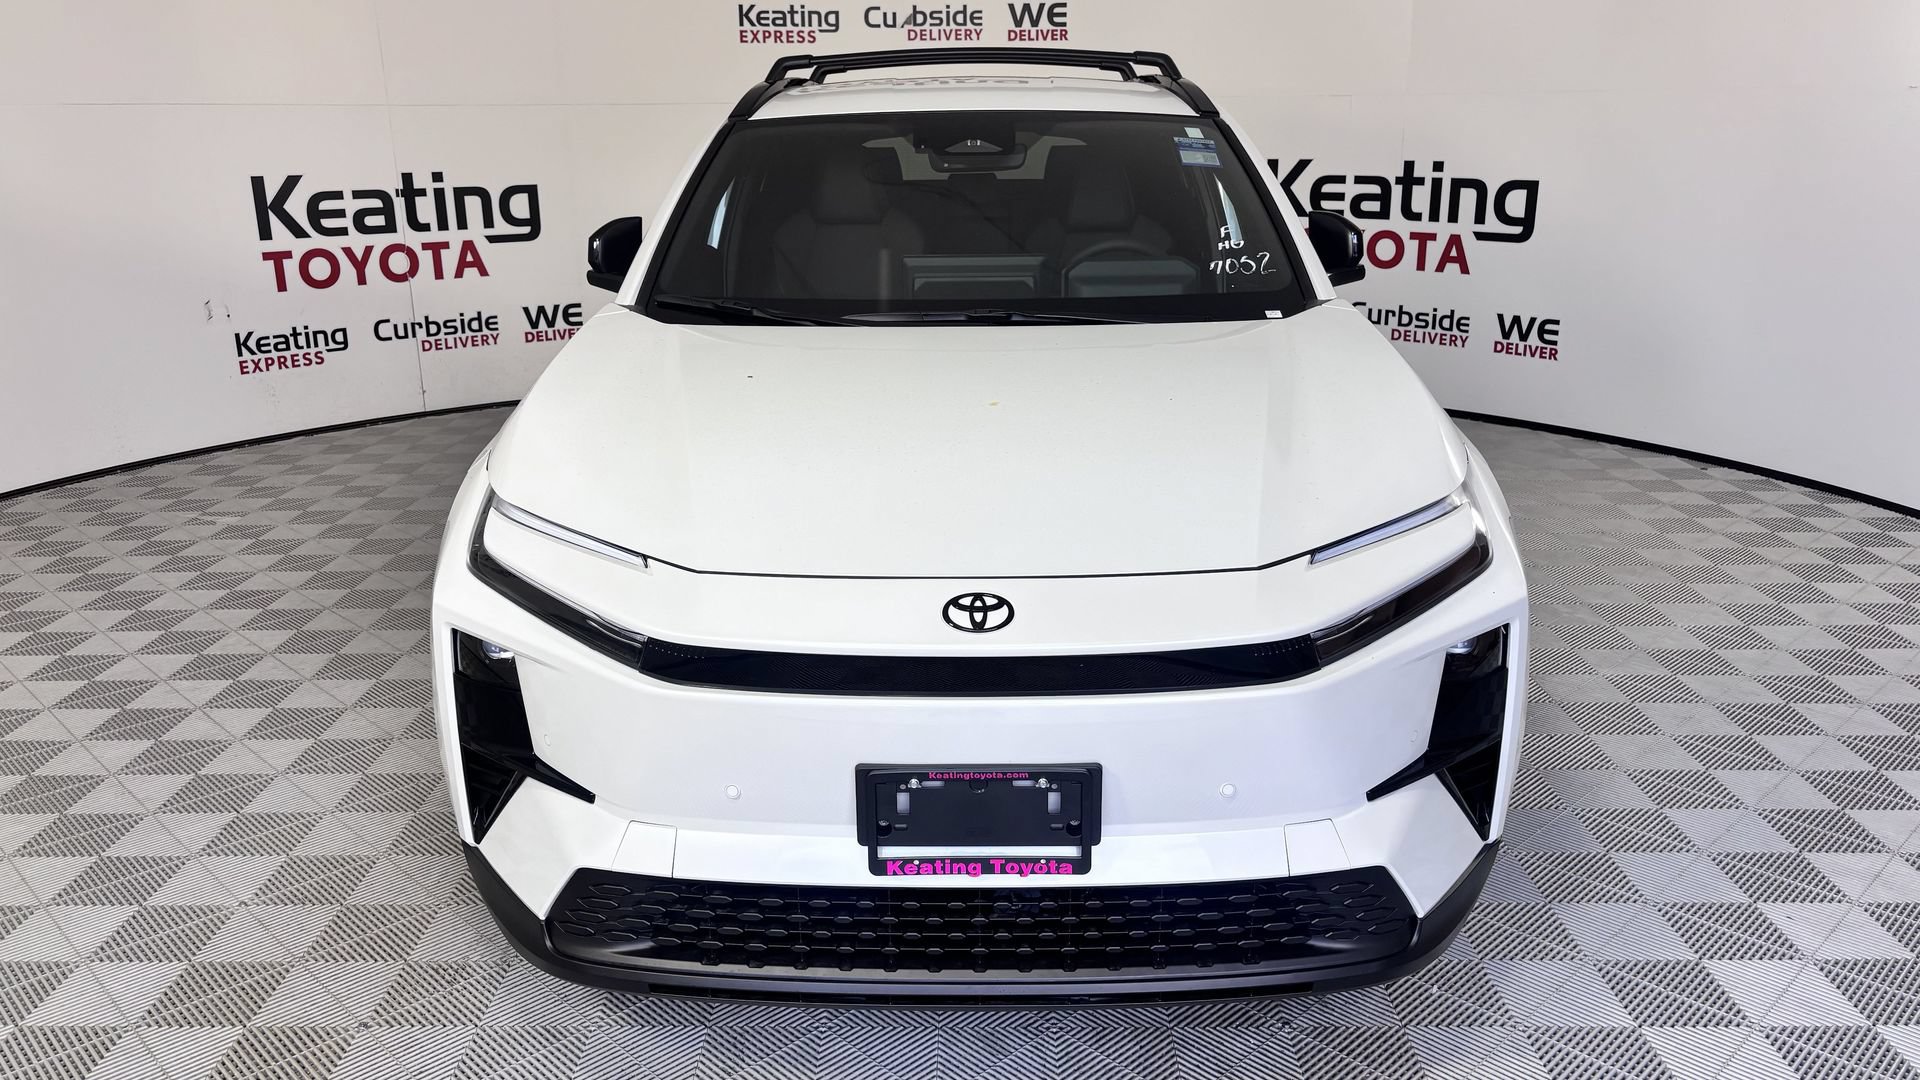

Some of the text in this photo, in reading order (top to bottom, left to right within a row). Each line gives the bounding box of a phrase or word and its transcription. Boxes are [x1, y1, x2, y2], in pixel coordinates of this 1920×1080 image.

[739, 4, 840, 33] Keating
[1008, 2, 1067, 28] WE
[739, 30, 817, 44] EXPRESS
[907, 28, 983, 41] DELIVERY
[1007, 29, 1069, 42] DELIVER
[250, 171, 541, 243] Keating
[1267, 158, 1540, 243] Keating
[262, 240, 490, 292] TOYOTA
[373, 311, 499, 341] Curbside
[522, 302, 583, 329] WE
[234, 325, 349, 357] Keating
[524, 328, 582, 343] DELIVE
[1391, 328, 1469, 348] DELIVERY
[1496, 313, 1561, 346] WE
[421, 333, 500, 352] DELIVERY
[1493, 340, 1559, 361] DELIVER
[239, 350, 325, 375] EXPRESS
[928, 771, 1029, 780] Keatingtoyota.com
[886, 859, 1073, 877] Keating Toyota
